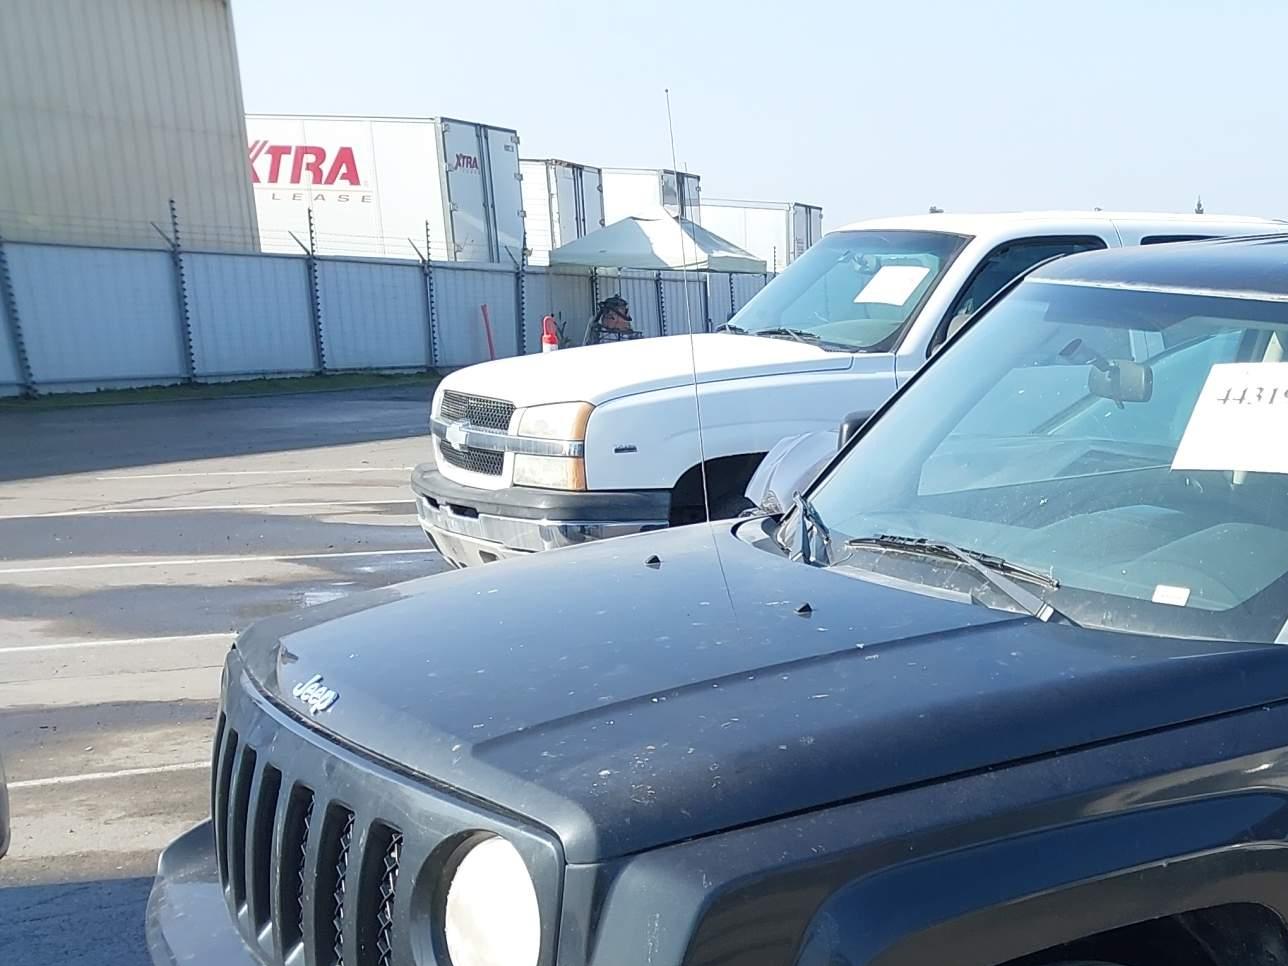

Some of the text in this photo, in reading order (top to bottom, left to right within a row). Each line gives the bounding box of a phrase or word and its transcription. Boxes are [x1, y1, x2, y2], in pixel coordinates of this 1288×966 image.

[454, 153, 479, 169] XTRA
[272, 193, 372, 203] LEASE
[293, 674, 338, 716] Jeep
